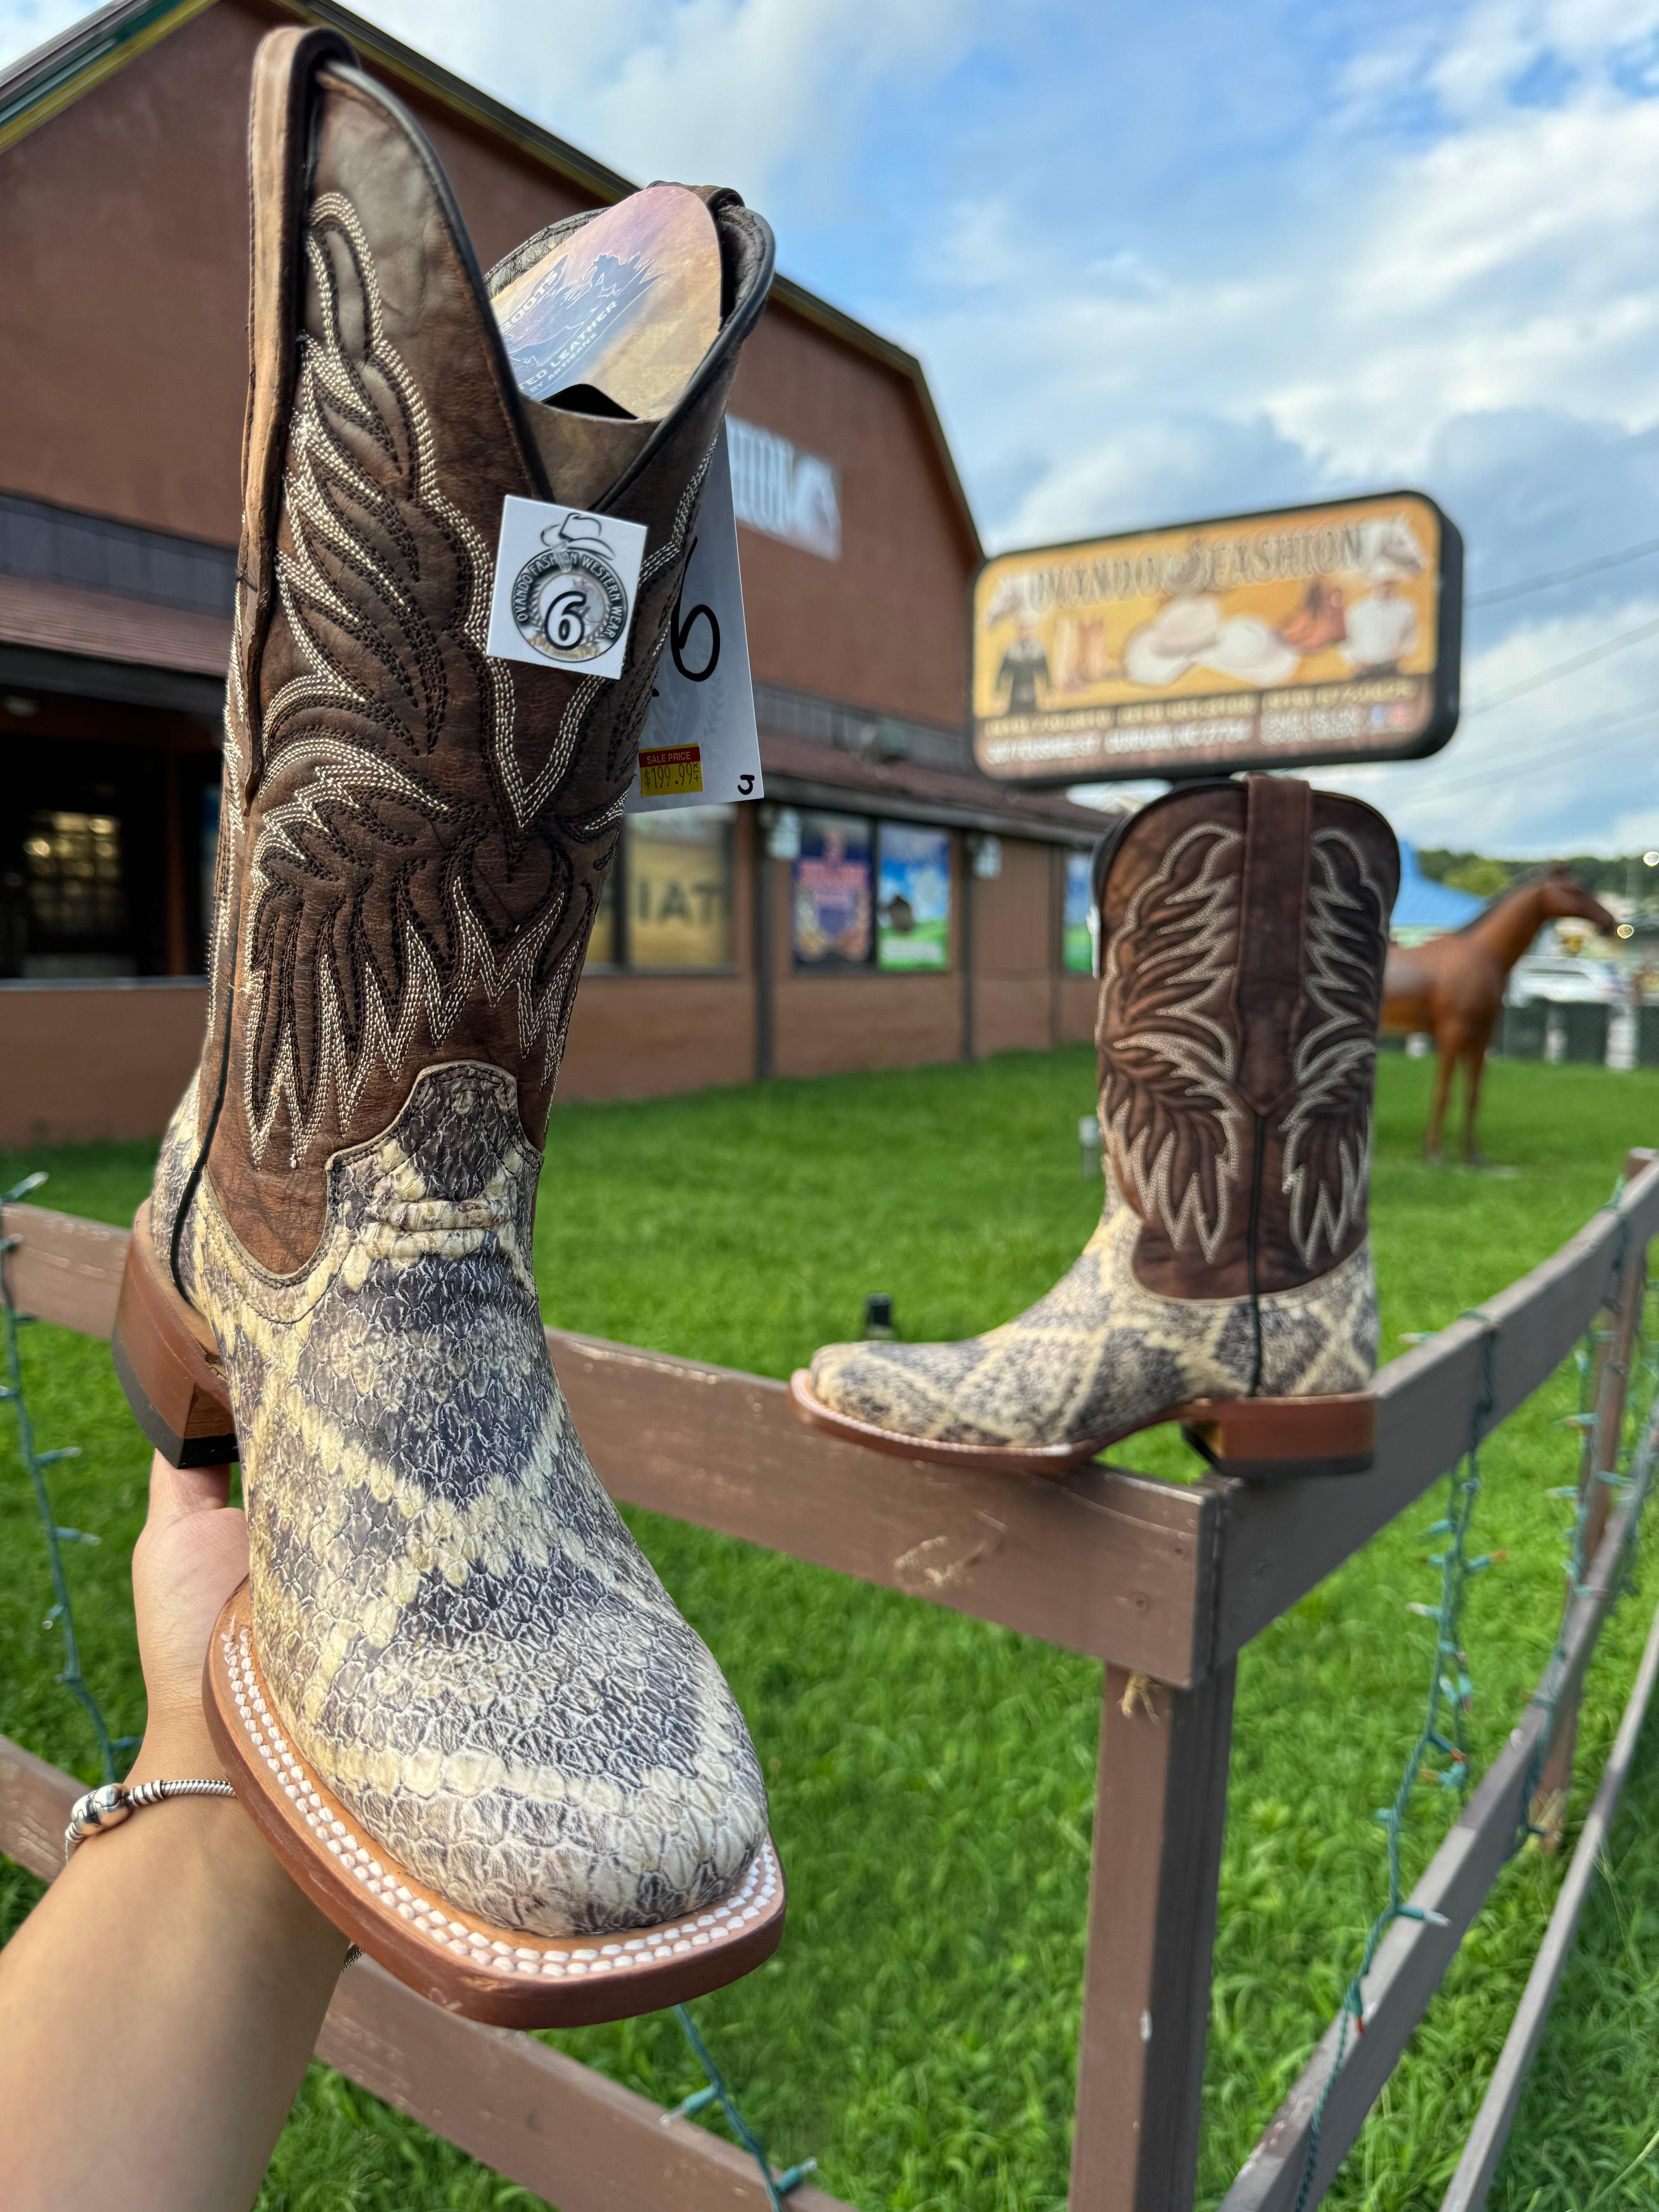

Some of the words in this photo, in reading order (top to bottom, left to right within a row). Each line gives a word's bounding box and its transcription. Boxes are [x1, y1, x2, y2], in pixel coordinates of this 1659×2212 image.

[517, 369, 548, 390] TED
[550, 301, 617, 368] LEATHER
[530, 381, 543, 392] BY
[548, 332, 597, 381] ARTISANS
[527, 551, 579, 576] FASHON
[582, 554, 622, 601] WESTERN
[514, 574, 532, 622] OVANDO
[544, 591, 587, 651] 6
[601, 606, 623, 638] WEAR
[644, 763, 692, 789] $199.99
[647, 754, 666, 764] SALE
[668, 752, 691, 762] PRICE
[637, 876, 728, 922] IAT
